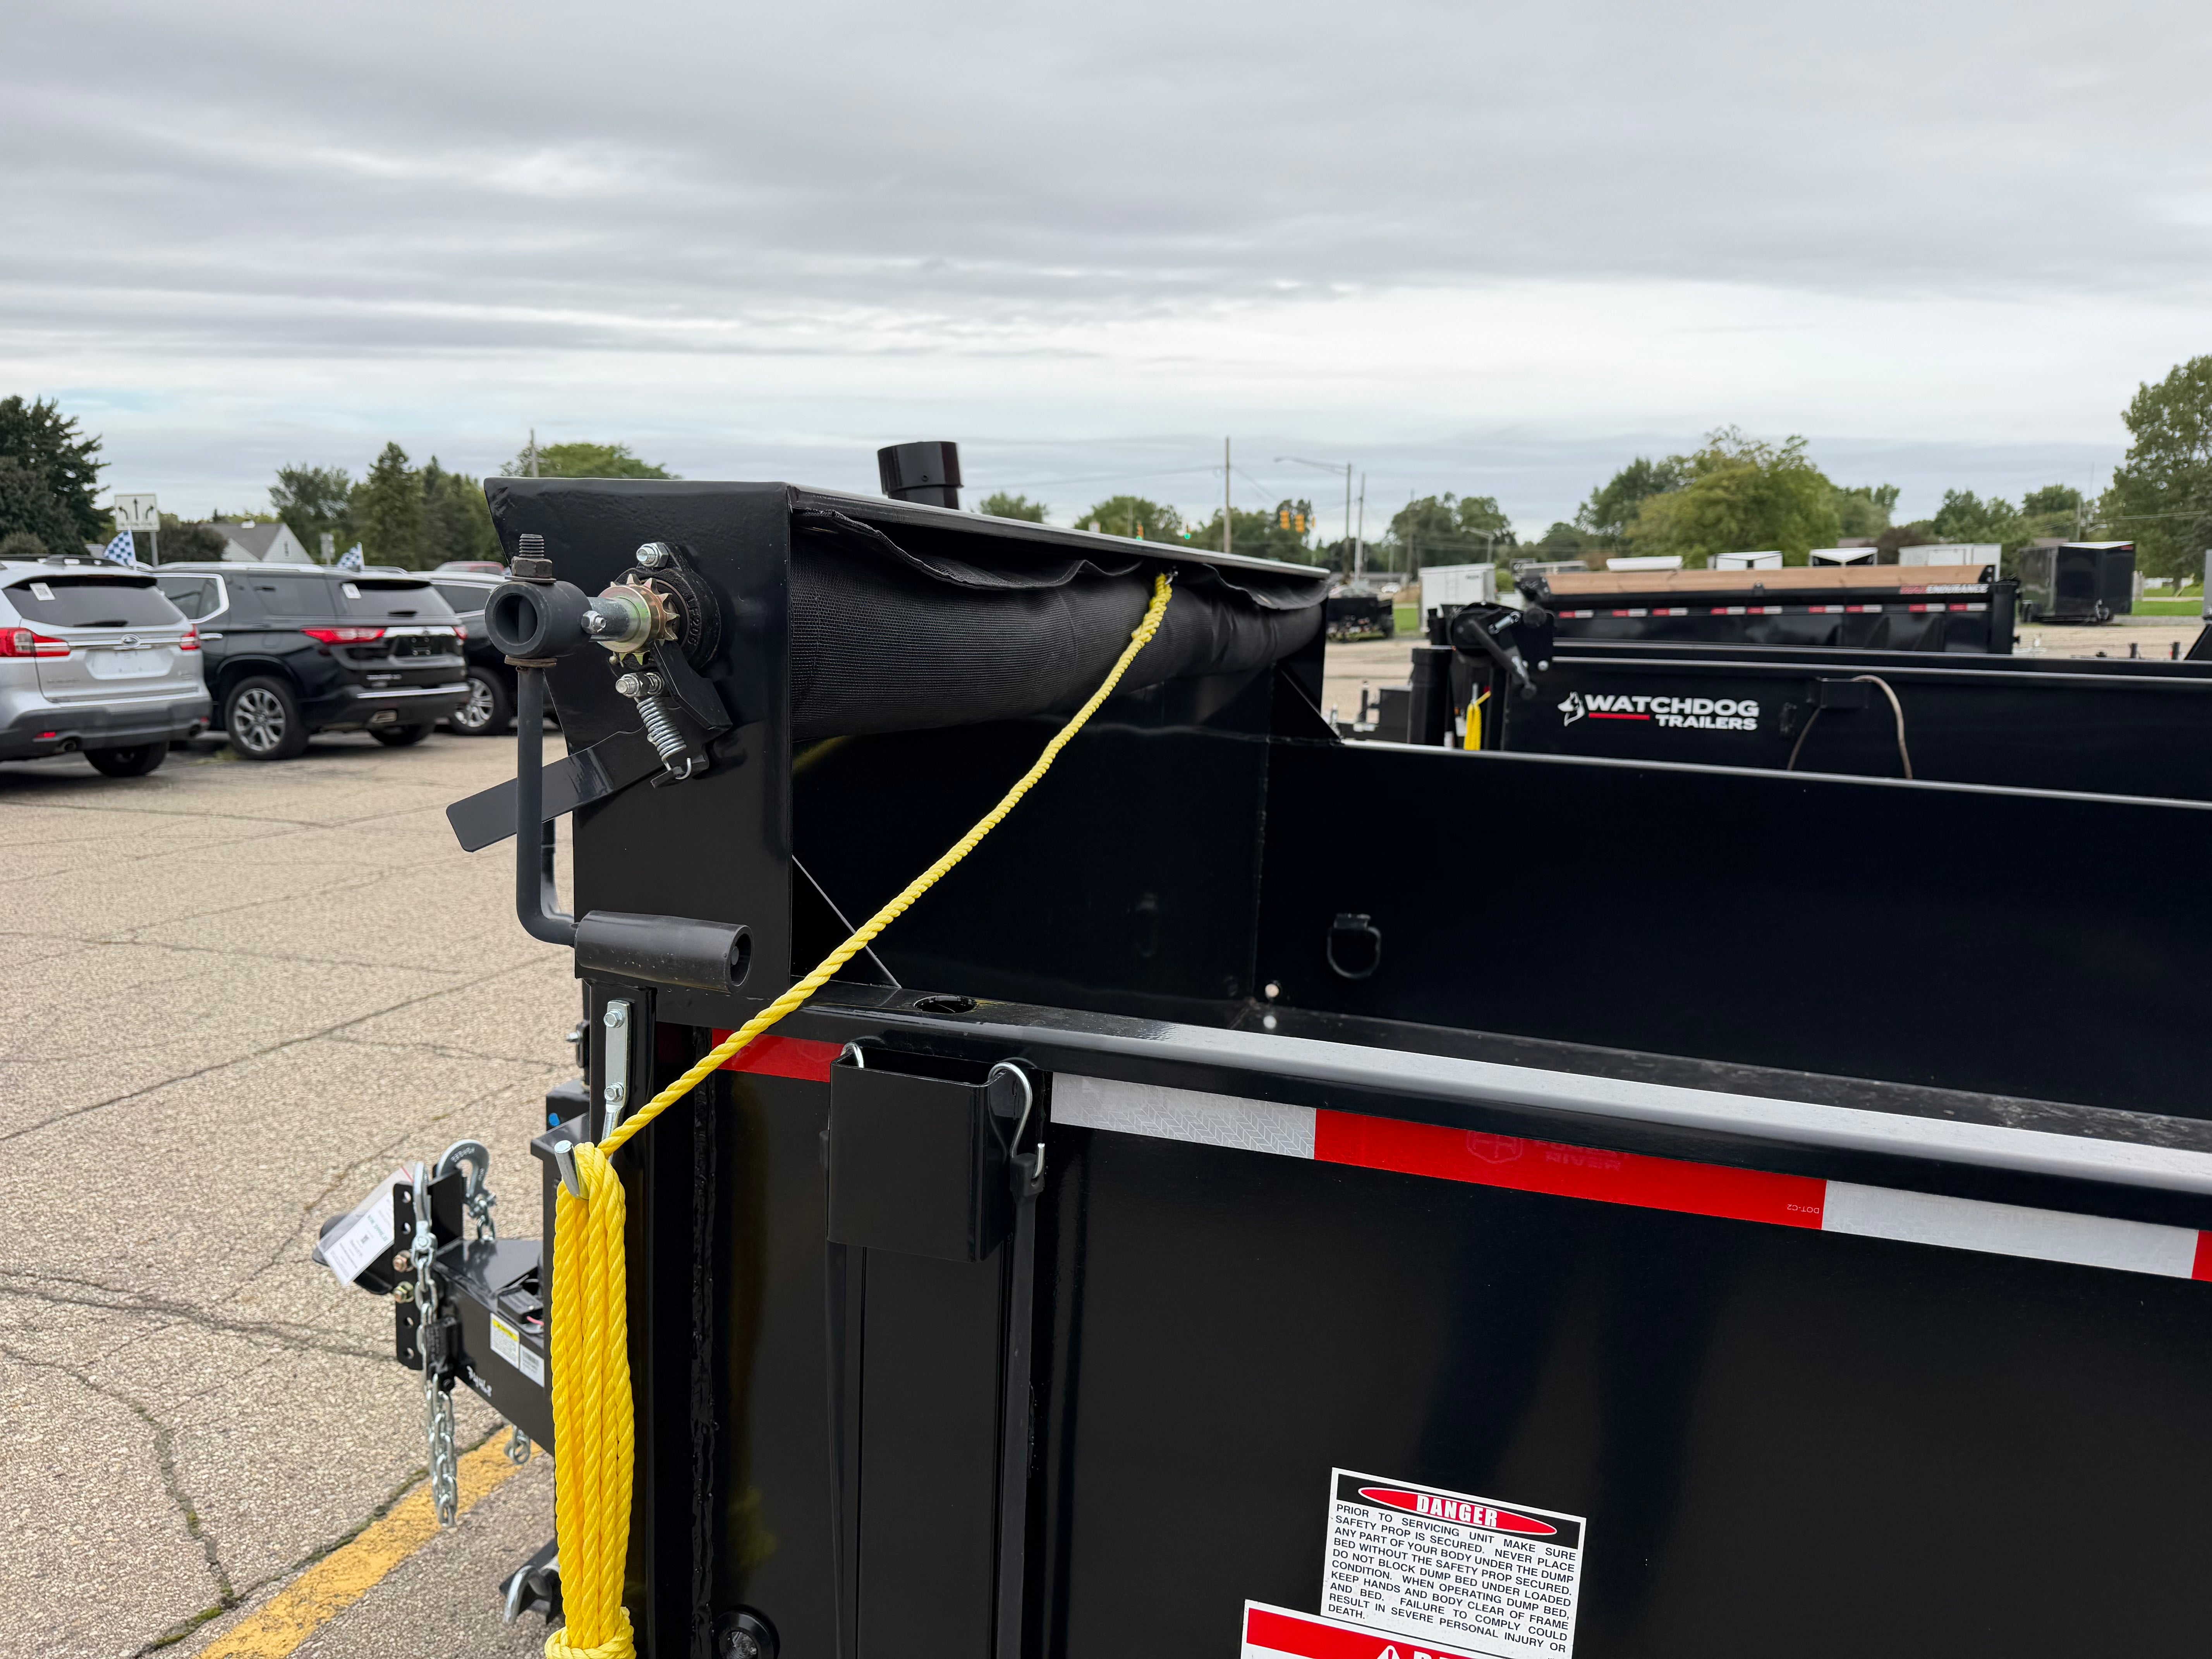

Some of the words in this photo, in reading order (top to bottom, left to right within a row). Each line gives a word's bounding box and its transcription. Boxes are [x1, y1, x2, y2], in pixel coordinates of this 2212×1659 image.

[1585, 694, 1760, 717] WATCHDOG
[1656, 714, 1758, 731] TRAILERS
[1787, 1204, 1820, 1214] DOT-C2
[1337, 1504, 1369, 1518] PRIOR
[1379, 1513, 1392, 1522] TO
[1402, 1518, 1459, 1536] SERVICING
[1470, 1532, 1494, 1543] UNIT
[1504, 1539, 1535, 1552] MAKE
[1546, 1548, 1576, 1561] SURE
[1416, 1494, 1498, 1527] DANGER
[1334, 1538, 1355, 1548] BED
[1360, 1543, 1408, 1559] WITHOUT
[1412, 1554, 1432, 1566] THE
[1436, 1560, 1478, 1575] SAFETY
[1482, 1570, 1511, 1582] PROP
[1516, 1577, 1571, 1595] SECURED.
[1335, 1527, 1356, 1537] ANY
[1360, 1532, 1387, 1544] PART
[1390, 1539, 1405, 1547] OF
[1408, 1542, 1437, 1555] YOUR
[1441, 1549, 1471, 1562] BODY
[1475, 1556, 1512, 1571] UNDER
[1516, 1565, 1537, 1576] THE
[1542, 1570, 1573, 1583] DUMP
[1336, 1516, 1376, 1530] SAFETY
[1382, 1525, 1410, 1537] PROP
[1416, 1532, 1424, 1540] IS
[1430, 1535, 1484, 1553] SECURED.
[1495, 1549, 1532, 1563] NEVER
[1538, 1558, 1574, 1572] PLACE
[1332, 1560, 1391, 1580] CONDITION.
[1403, 1575, 1434, 1589] WHEN
[1439, 1584, 1501, 1603] OPERATING
[1507, 1598, 1539, 1611] DUMP
[1544, 1606, 1569, 1620] BED,
[1332, 1571, 1358, 1583] KEEP
[1364, 1578, 1400, 1592] HANDS
[1405, 1588, 1427, 1598] AND
[1432, 1594, 1463, 1606] BODY
[1468, 1602, 1504, 1616] CLEAR
[1510, 1611, 1524, 1619] OF
[1530, 1614, 1568, 1630] FRAME
[1333, 1549, 1348, 1558] DO
[1353, 1553, 1374, 1564] NOT
[1379, 1559, 1415, 1573] BLOCK
[1420, 1568, 1450, 1580] DUMP
[1455, 1575, 1477, 1586] BED
[1482, 1581, 1520, 1596] UNDER
[1525, 1590, 1570, 1606] LOADED
[1329, 1604, 1364, 1619] DEATH.
[1330, 1583, 1352, 1593] AND
[1360, 1589, 1384, 1601] BED.
[1400, 1598, 1444, 1614] FAILURE
[1453, 1609, 1467, 1619] TO
[1475, 1614, 1520, 1630] COMPLY
[1528, 1626, 1567, 1640] COULD
[1330, 1593, 1369, 1608] RESULT
[1376, 1604, 1385, 1612] IN
[1391, 1607, 1433, 1623] SEVERE
[1440, 1618, 1498, 1637] PERSONAL
[1505, 1632, 1544, 1647] INJURY
[1550, 1643, 1565, 1652] OR
